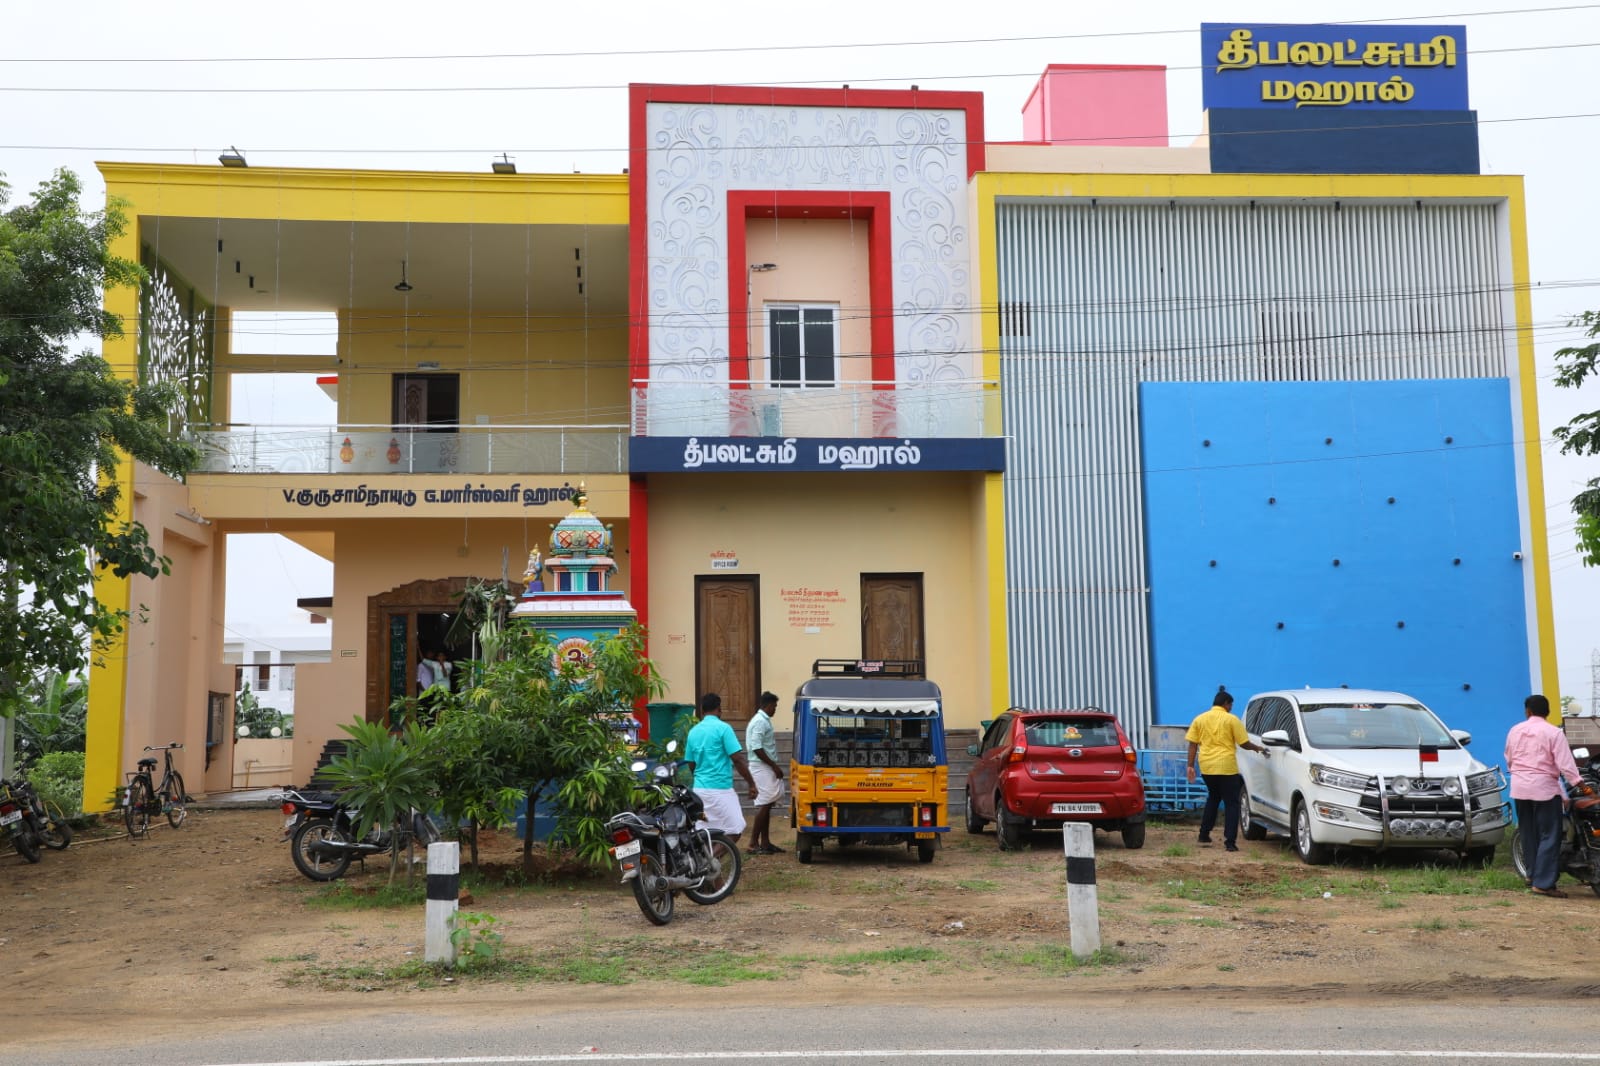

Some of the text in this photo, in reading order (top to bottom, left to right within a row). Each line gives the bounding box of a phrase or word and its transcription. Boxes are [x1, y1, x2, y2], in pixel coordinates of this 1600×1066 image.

[1216, 29, 1456, 74] தீபலட்சுமி
[1261, 75, 1415, 109] மஹால்
[683, 437, 922, 470] தீபலட்சுமி மஹால்
